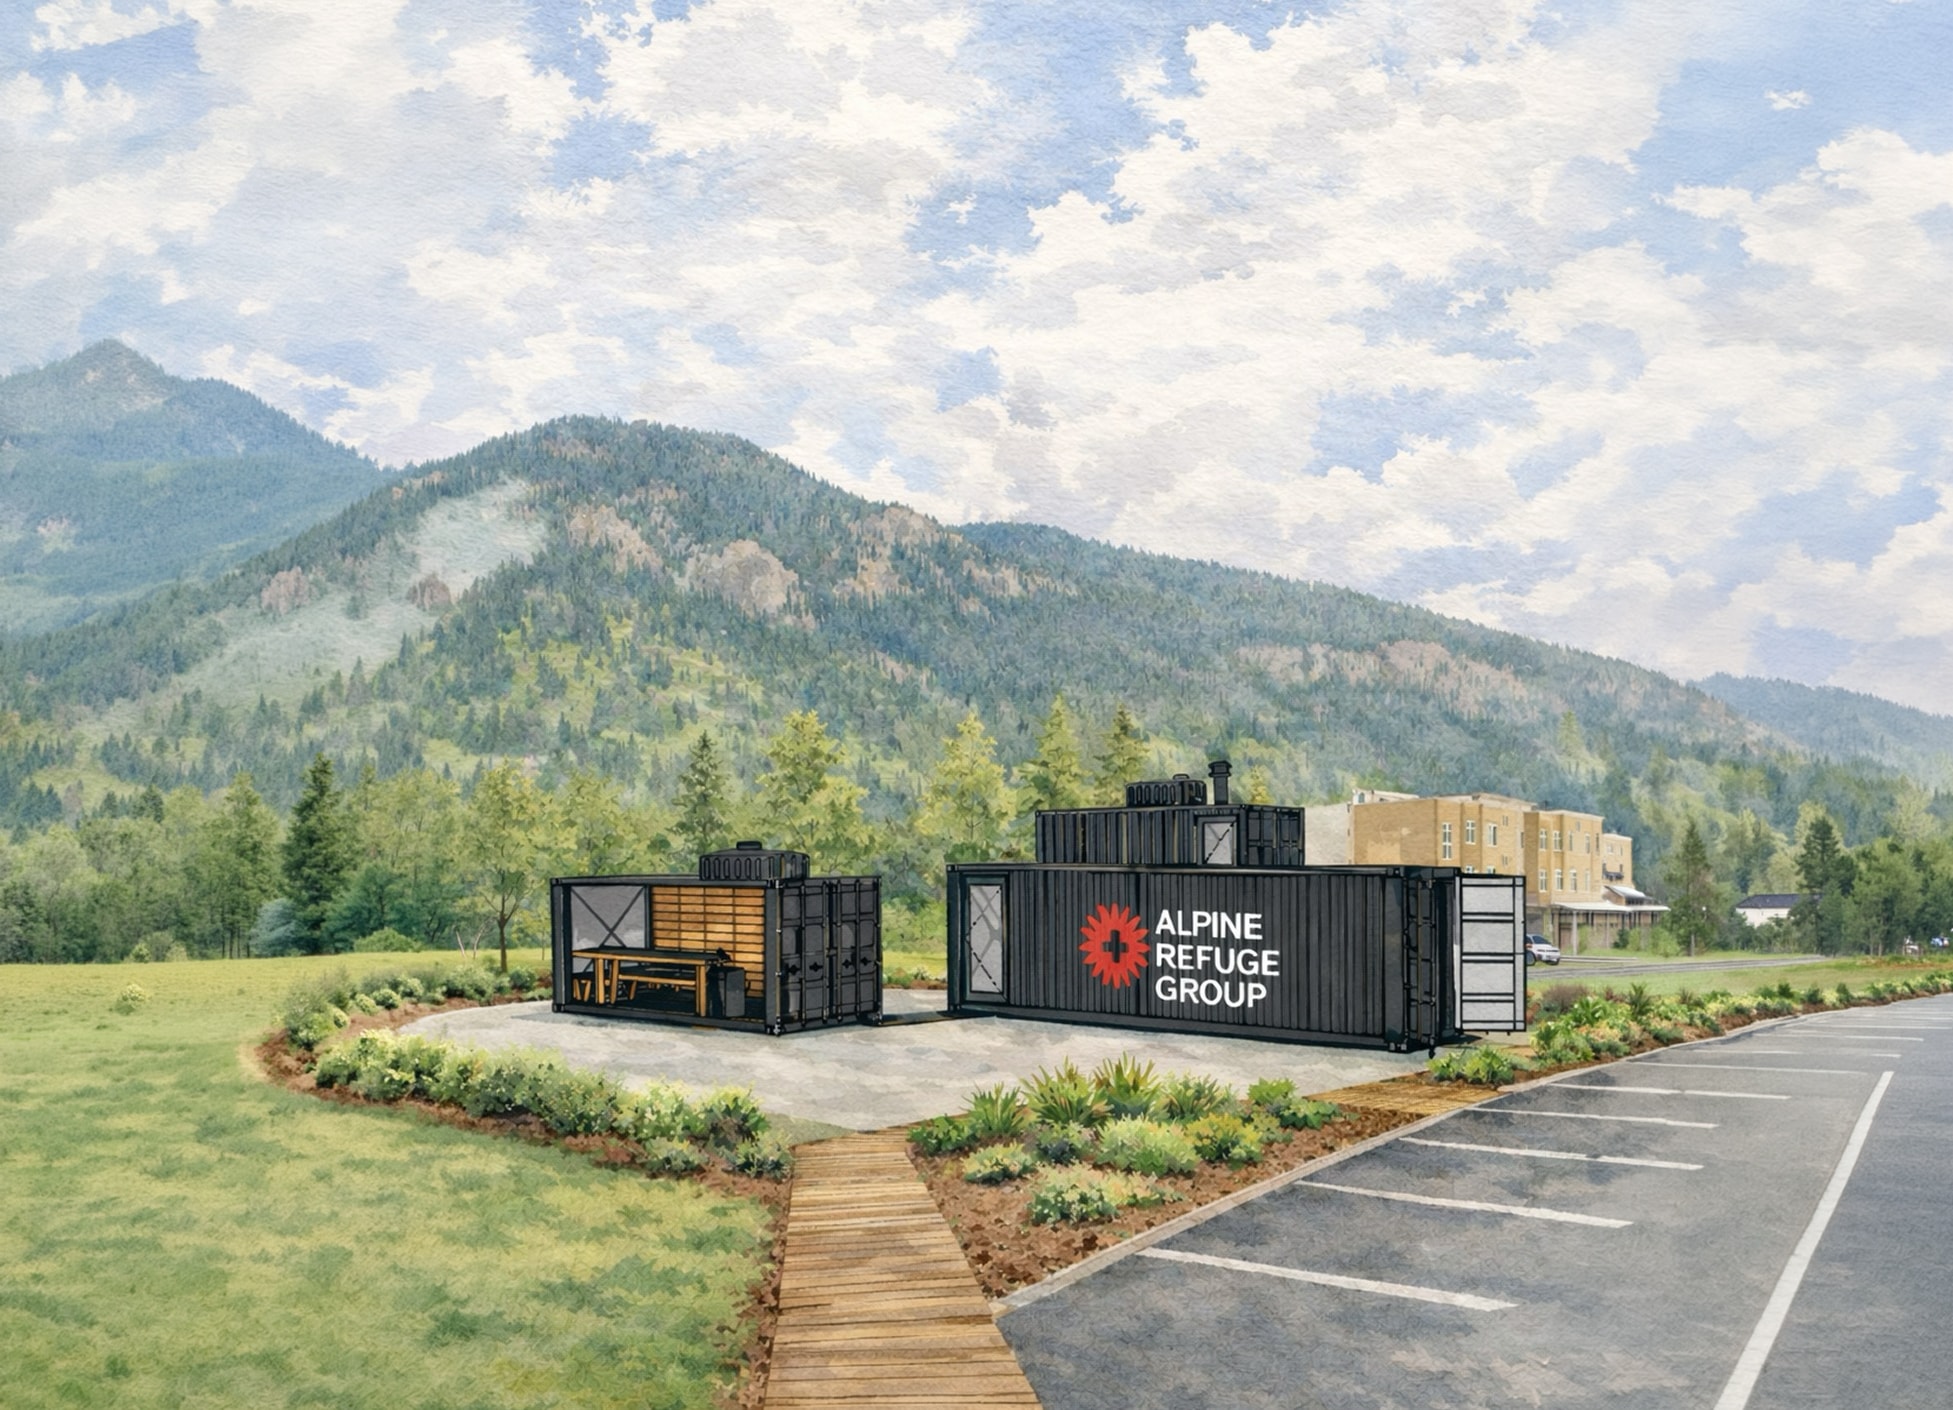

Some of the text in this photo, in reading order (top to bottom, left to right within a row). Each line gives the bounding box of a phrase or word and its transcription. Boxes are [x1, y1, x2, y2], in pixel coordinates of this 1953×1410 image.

[1155, 908, 1263, 940] ALPINE
[1156, 942, 1280, 976] REFUGE
[1155, 975, 1268, 1009] GROUP
